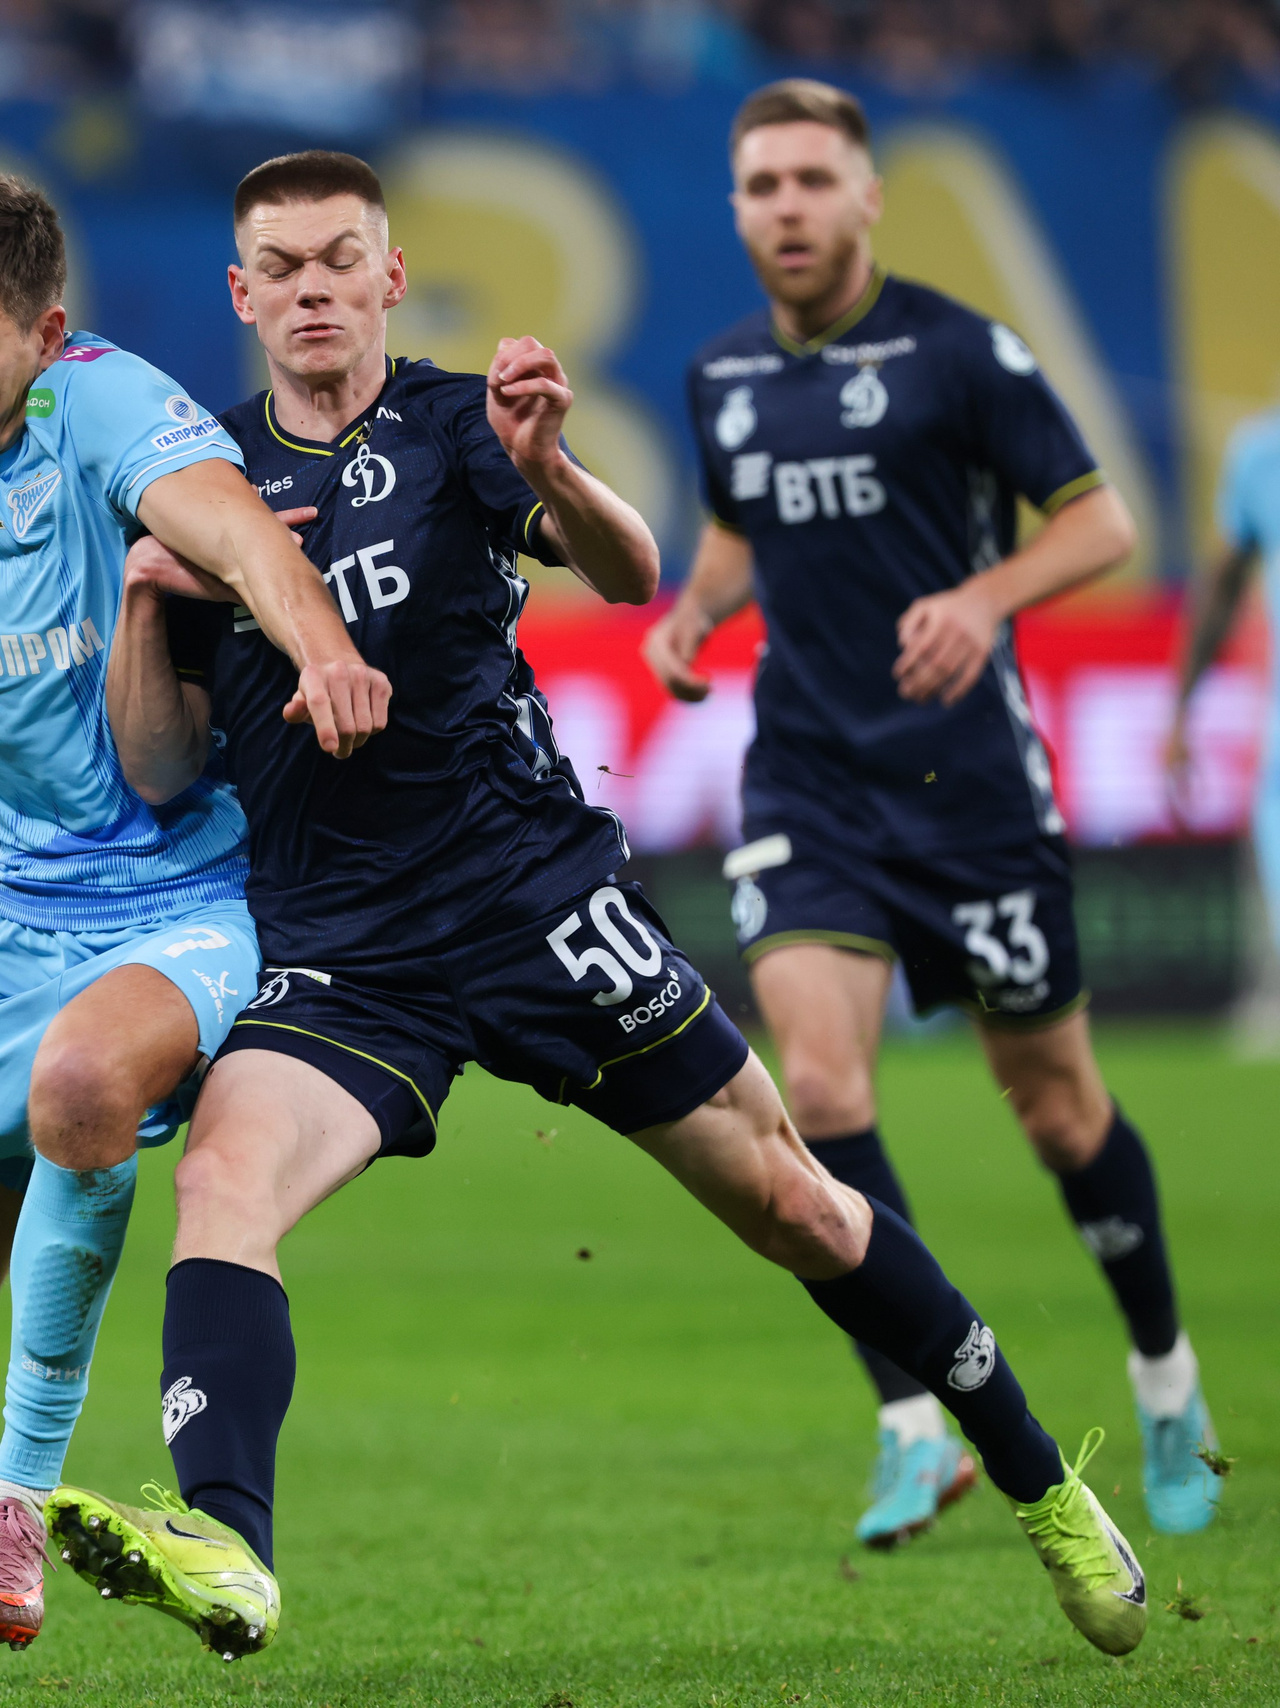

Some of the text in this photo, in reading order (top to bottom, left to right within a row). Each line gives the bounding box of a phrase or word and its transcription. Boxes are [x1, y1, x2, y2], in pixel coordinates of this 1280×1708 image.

[257, 475, 294, 498] ries
[773, 453, 888, 526] ВТБ
[321, 538, 411, 625] ТБ
[545, 886, 663, 1007] 50
[952, 888, 1049, 986] 33
[618, 981, 682, 1034] BOSCO
[20, 1354, 91, 1381] ЗЕНИТ
